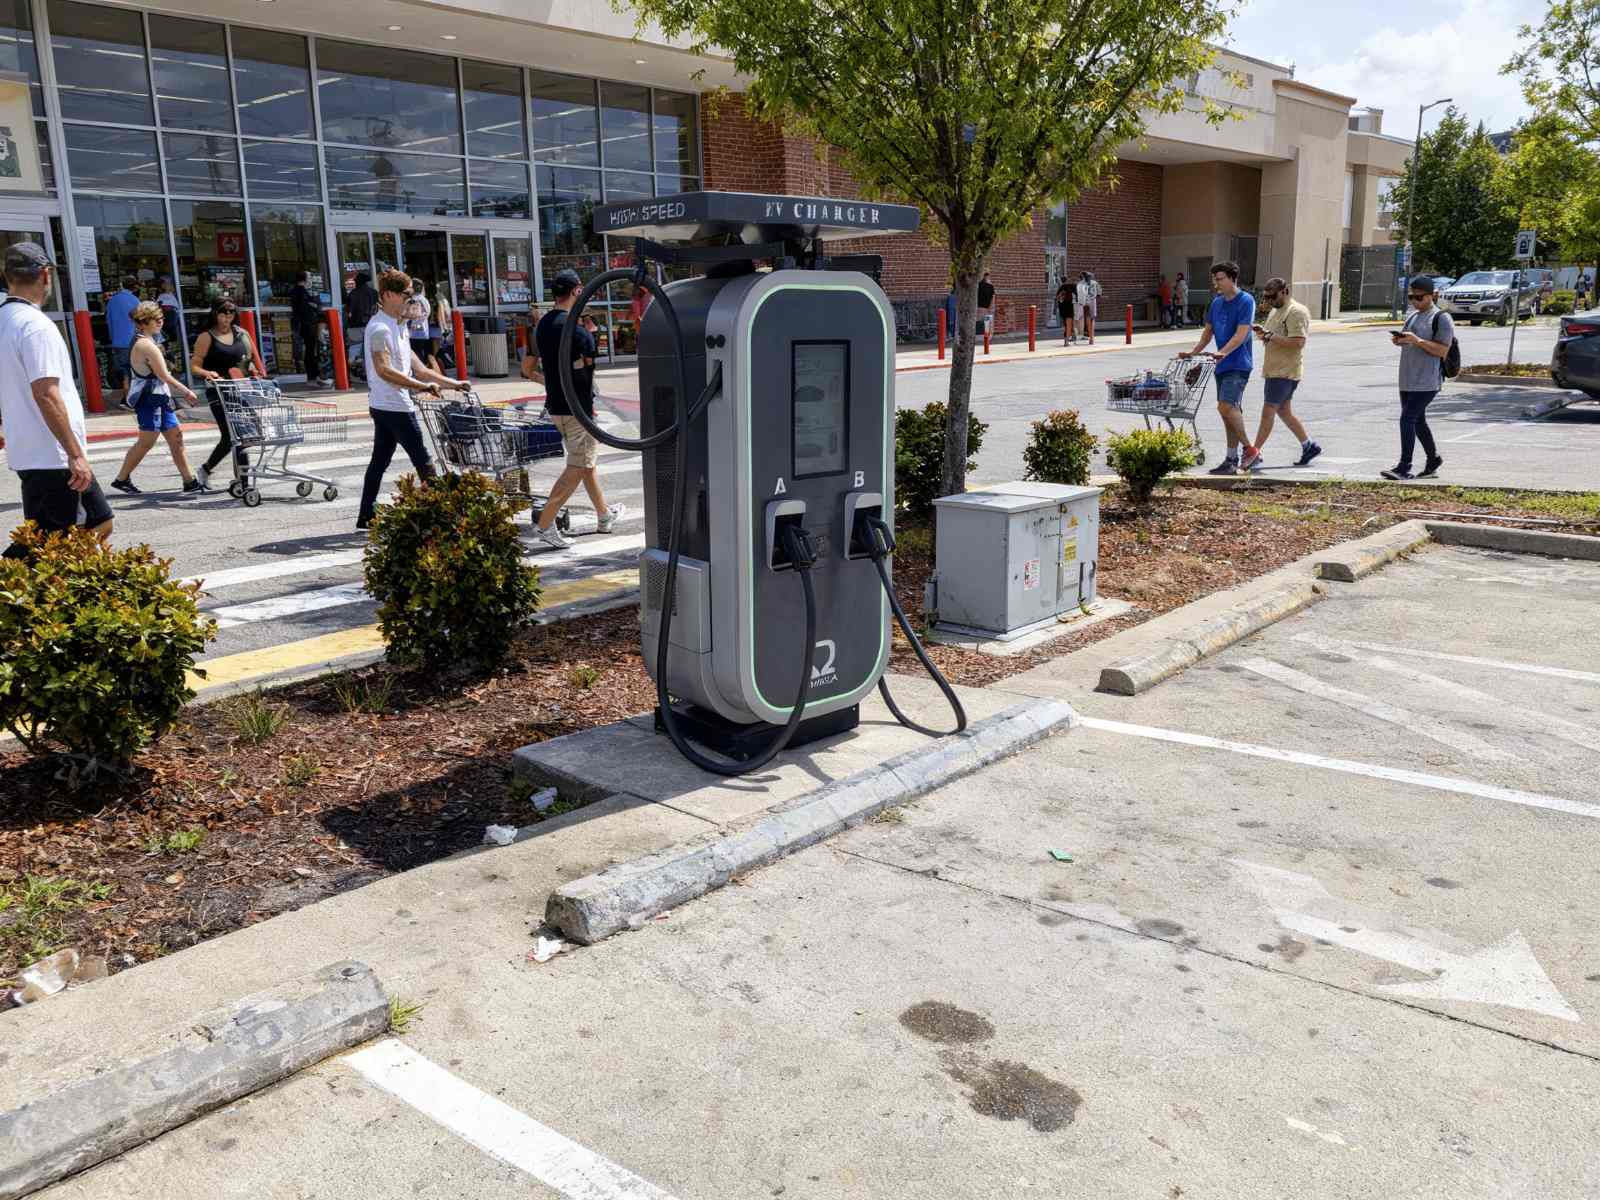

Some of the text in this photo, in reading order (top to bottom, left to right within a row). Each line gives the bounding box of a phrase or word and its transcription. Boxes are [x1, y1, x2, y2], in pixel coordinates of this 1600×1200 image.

[641, 202, 686, 221] SPEED
[793, 203, 880, 224] CHARGER
[774, 477, 787, 495] A
[854, 470, 865, 488] B
